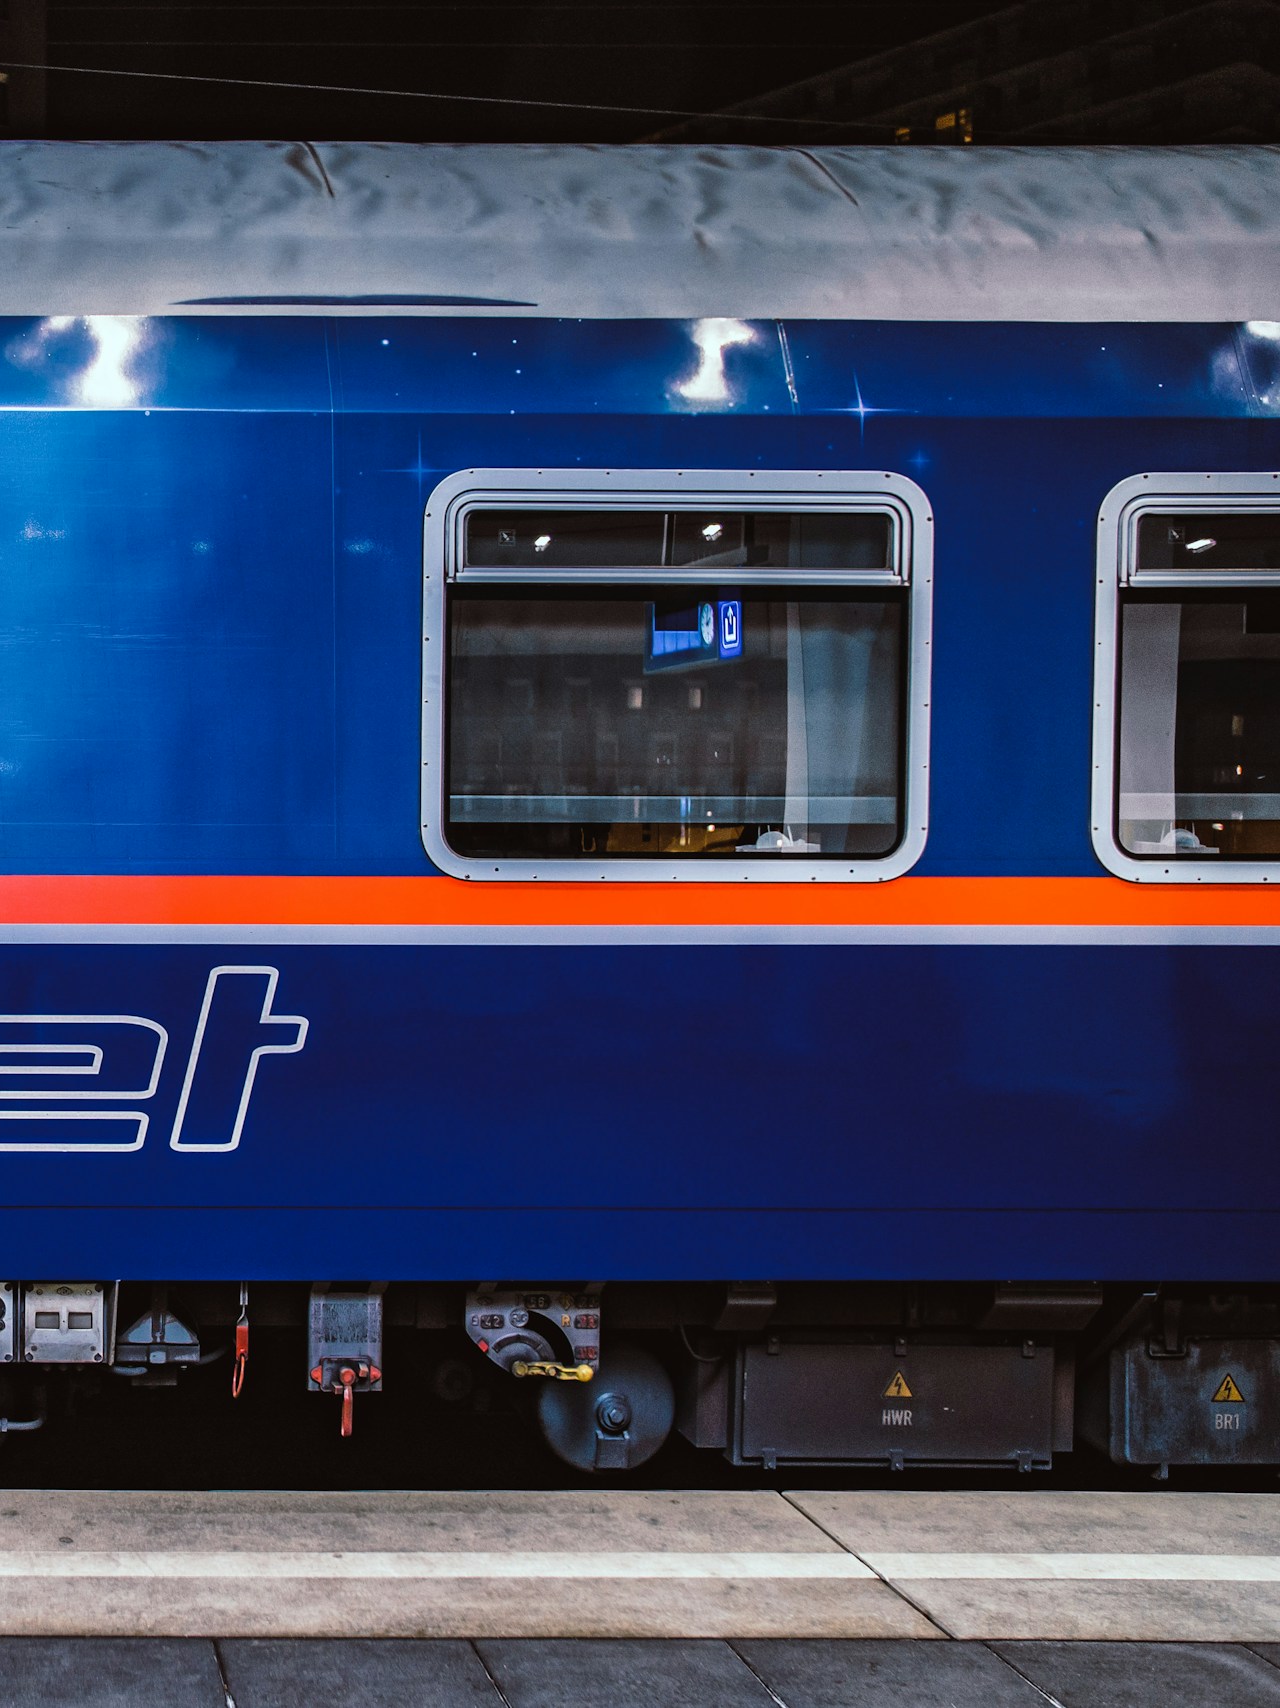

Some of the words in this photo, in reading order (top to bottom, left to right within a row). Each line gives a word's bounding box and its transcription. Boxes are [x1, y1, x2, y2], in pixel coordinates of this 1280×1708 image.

[561, 1313, 571, 1327] R
[882, 1409, 913, 1427] HWR
[1215, 1413, 1240, 1430] BR1
